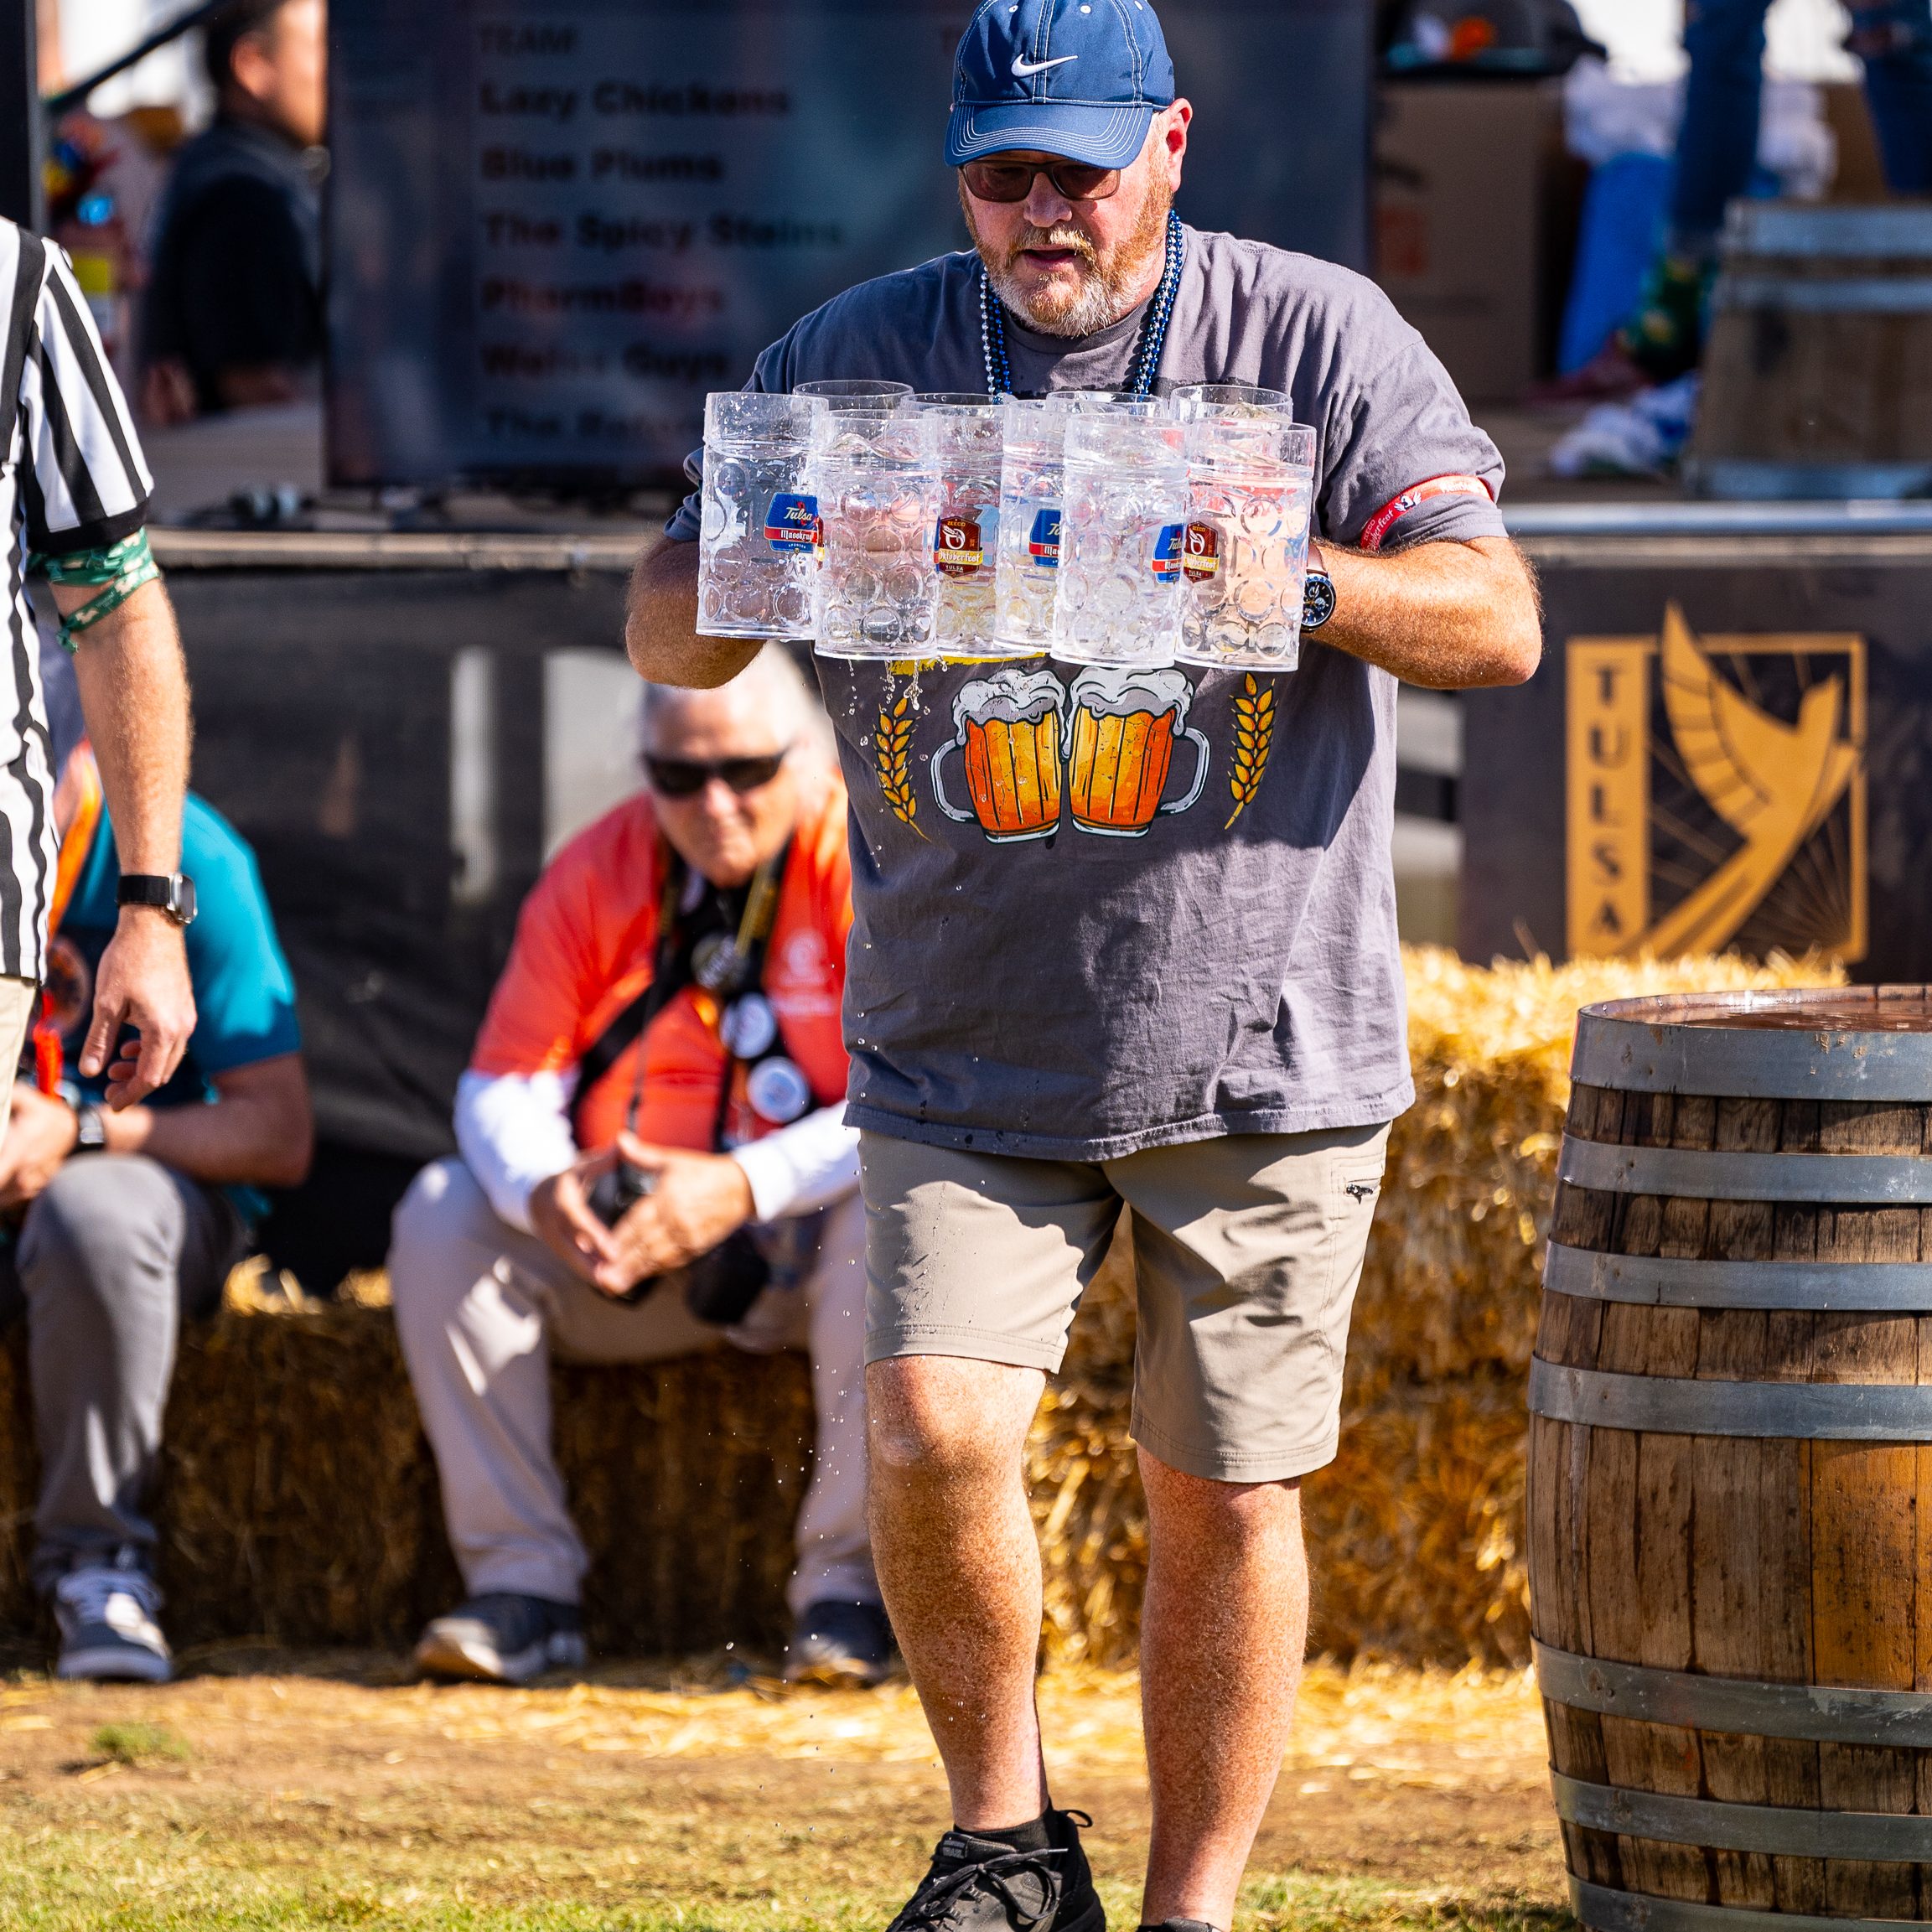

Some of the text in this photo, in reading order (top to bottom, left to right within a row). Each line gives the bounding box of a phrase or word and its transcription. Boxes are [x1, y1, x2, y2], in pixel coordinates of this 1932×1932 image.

[479, 24, 578, 55] TEAM
[479, 80, 792, 123] Lazy Chickens
[481, 148, 727, 182] Blue Plums
[481, 213, 562, 247] The
[576, 211, 693, 256] Spicy
[784, 506, 813, 521] Tulsa
[1168, 537, 1182, 550] Tuls
[1589, 659, 1630, 935] TULSA
